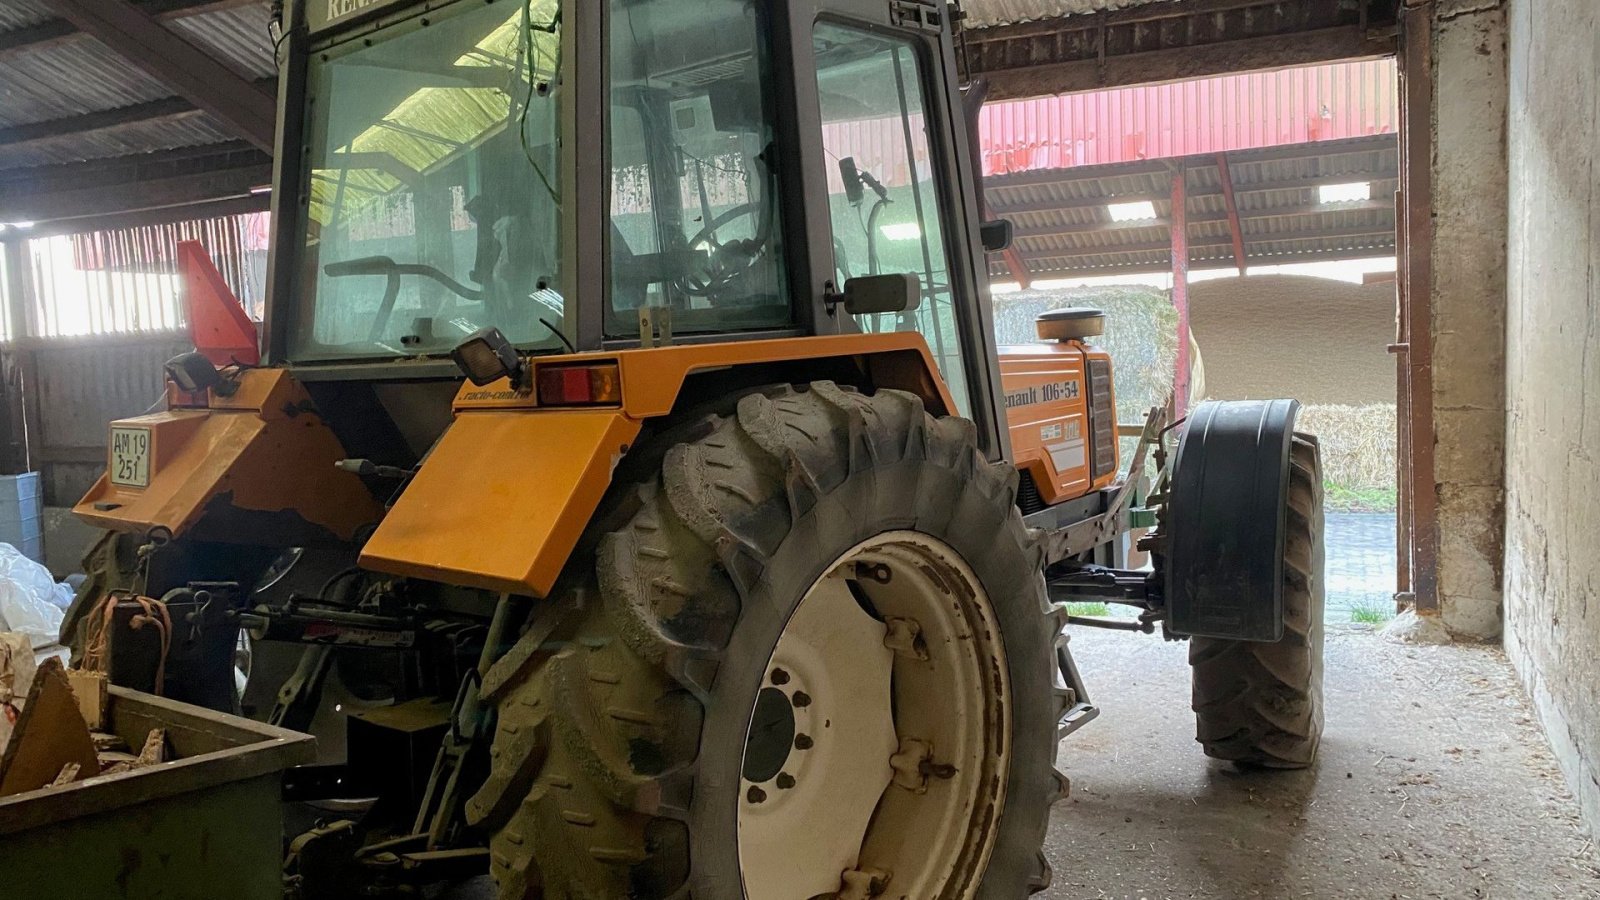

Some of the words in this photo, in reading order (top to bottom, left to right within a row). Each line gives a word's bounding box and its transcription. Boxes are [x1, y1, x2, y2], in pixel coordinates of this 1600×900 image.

[114, 433, 130, 454] AM
[133, 434, 147, 456] 19
[118, 458, 138, 481] 251
